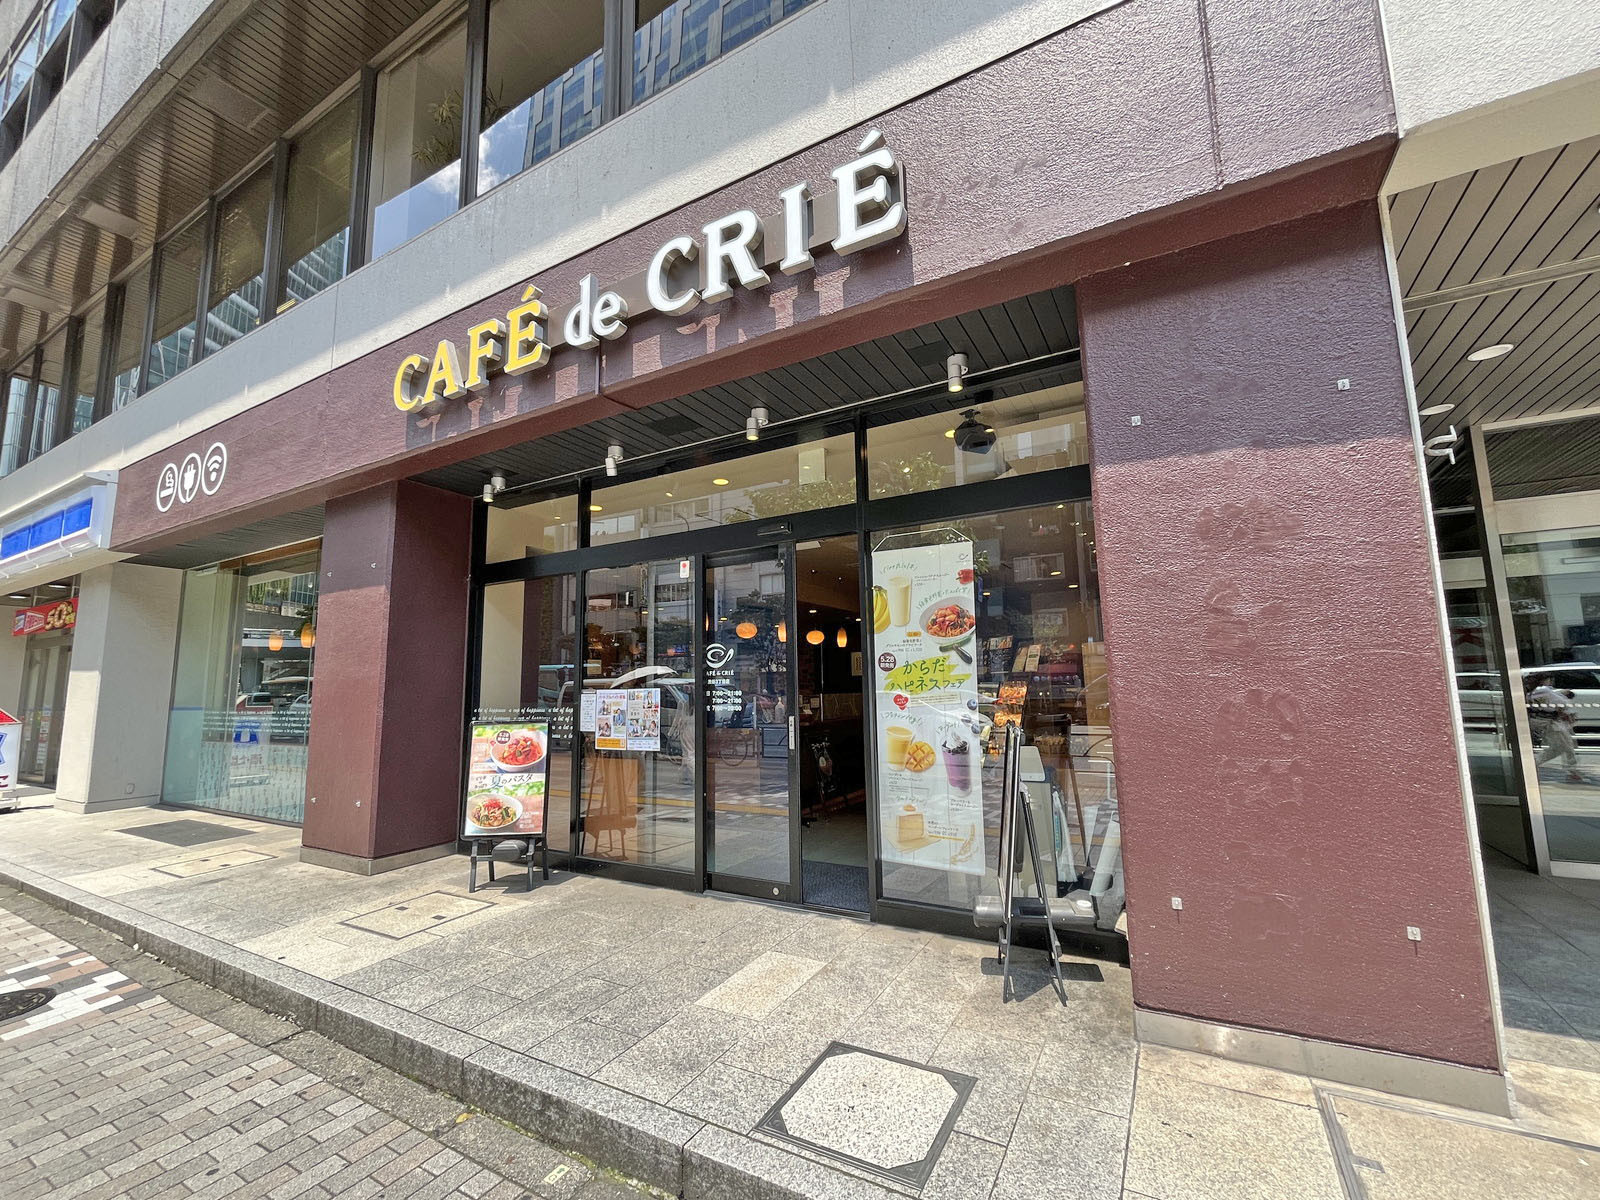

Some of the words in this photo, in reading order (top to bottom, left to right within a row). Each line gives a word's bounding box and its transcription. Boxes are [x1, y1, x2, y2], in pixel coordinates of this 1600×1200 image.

[394, 284, 550, 412] CAFÉ
[564, 272, 628, 349] de
[646, 129, 906, 316] CRIÉ
[903, 658, 946, 675] からだ
[889, 676, 965, 692] ハピネスフェア
